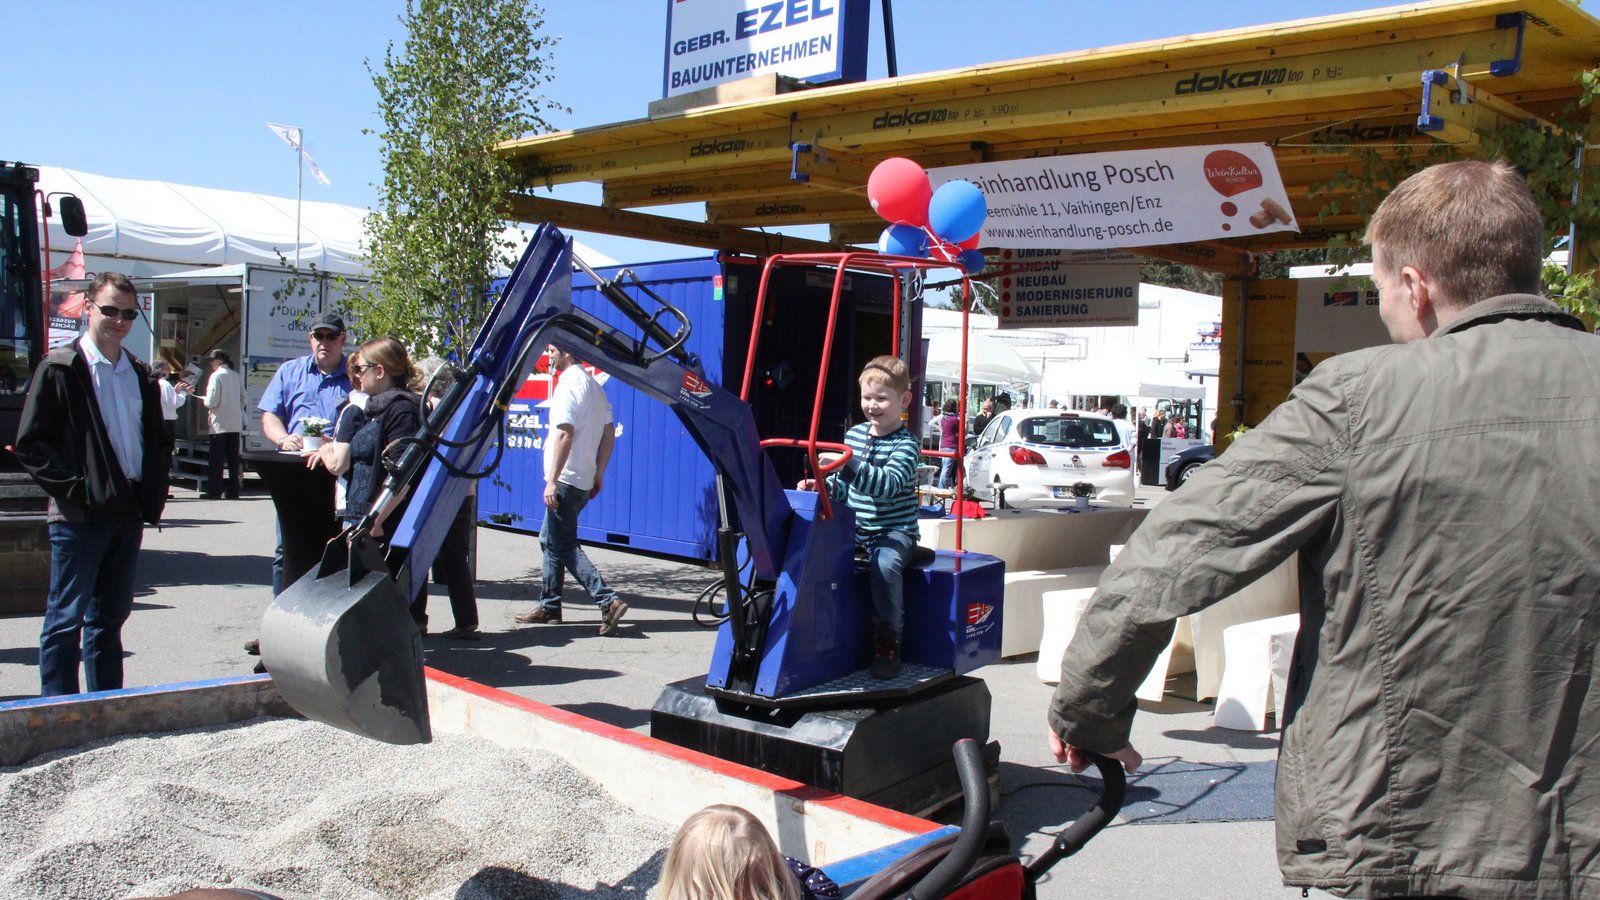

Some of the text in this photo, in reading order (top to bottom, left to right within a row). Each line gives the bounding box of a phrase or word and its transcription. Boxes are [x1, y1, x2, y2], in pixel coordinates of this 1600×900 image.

[674, 0, 834, 56] GEBR. EZEL
[672, 34, 832, 89] BAUUNTERNEHMEN
[1175, 70, 1263, 95] doka
[1261, 67, 1287, 86] H20
[1287, 68, 1303, 82] top
[872, 109, 931, 130] doka
[690, 139, 734, 157] doka
[950, 159, 1174, 194] einhandlung Posch
[1205, 165, 1258, 178] WeinKultur
[986, 195, 1163, 218] eemühle 11, Vaihingen/Enz
[985, 217, 1174, 241] www.weinhandlung-posch.de
[1016, 274, 1067, 288] NEUBAU
[1016, 286, 1134, 303] MODERNISIERUNG
[1016, 304, 1089, 317] SANIERUNG
